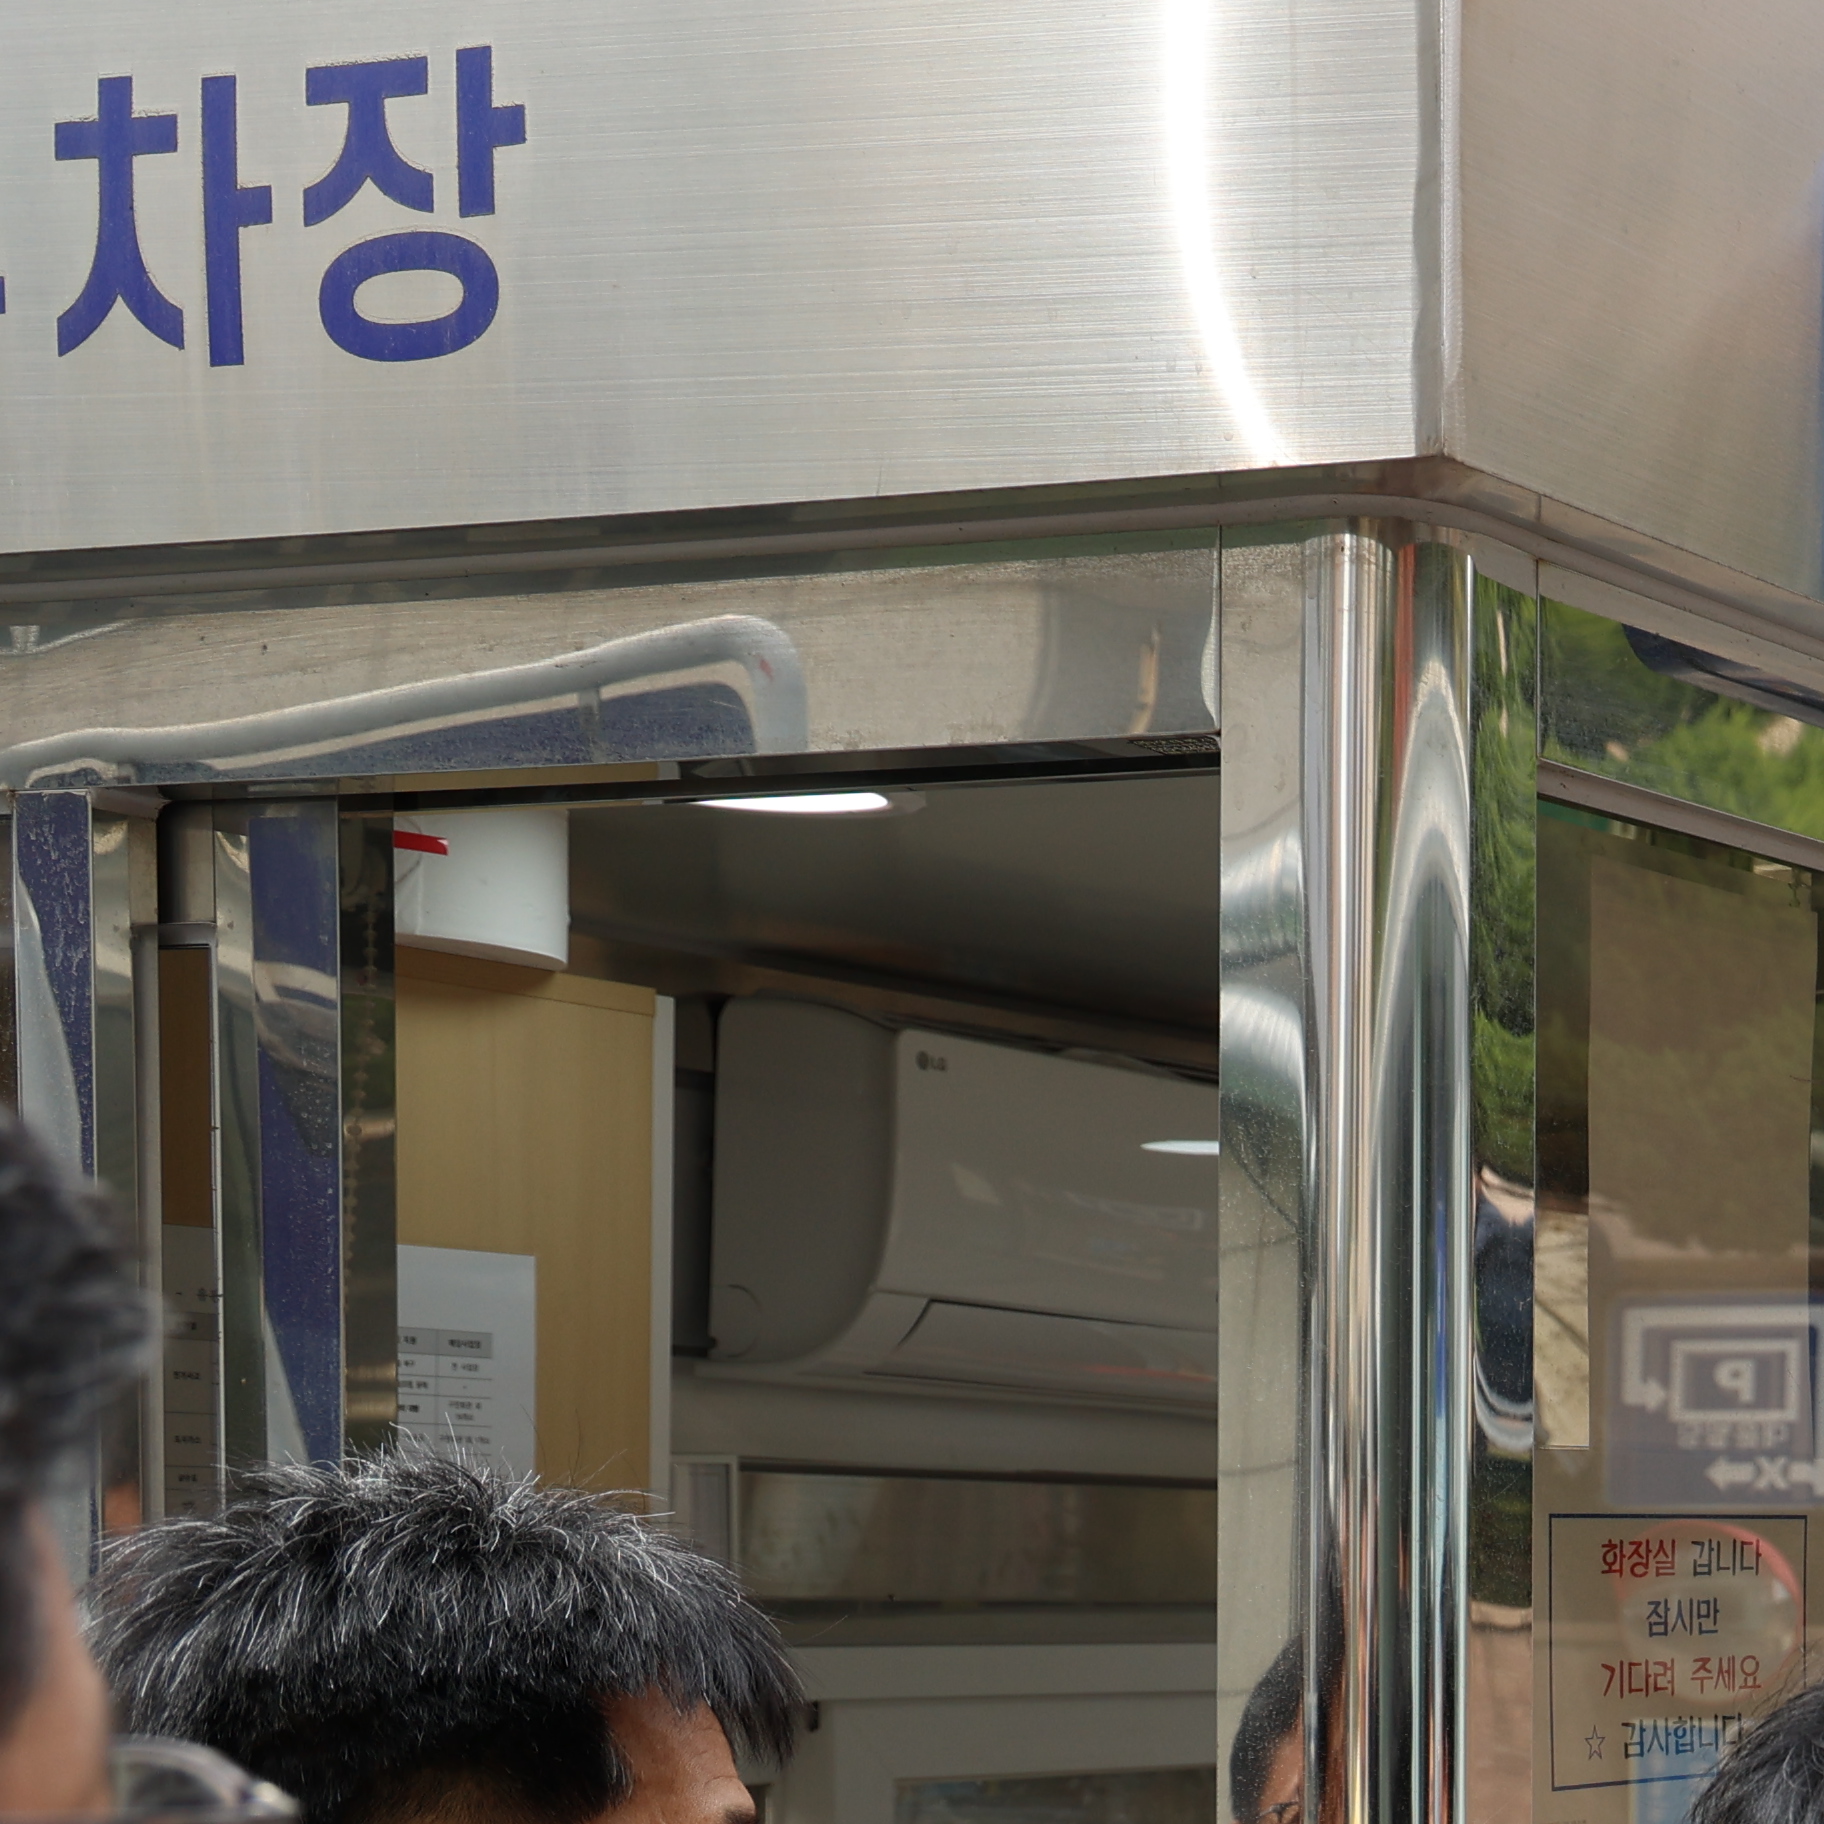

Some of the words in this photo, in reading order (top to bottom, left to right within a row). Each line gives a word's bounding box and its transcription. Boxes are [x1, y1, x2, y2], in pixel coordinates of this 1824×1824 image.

[0, 44, 527, 368] 차장
[1601, 1538, 1675, 1579] 화장실
[1691, 1537, 1762, 1577] 갑니다
[1646, 1597, 1719, 1637] 잠시만
[1601, 1657, 1675, 1699] 기다려
[1690, 1654, 1762, 1694] 주세요
[1621, 1712, 1742, 1759] 감사합니다
